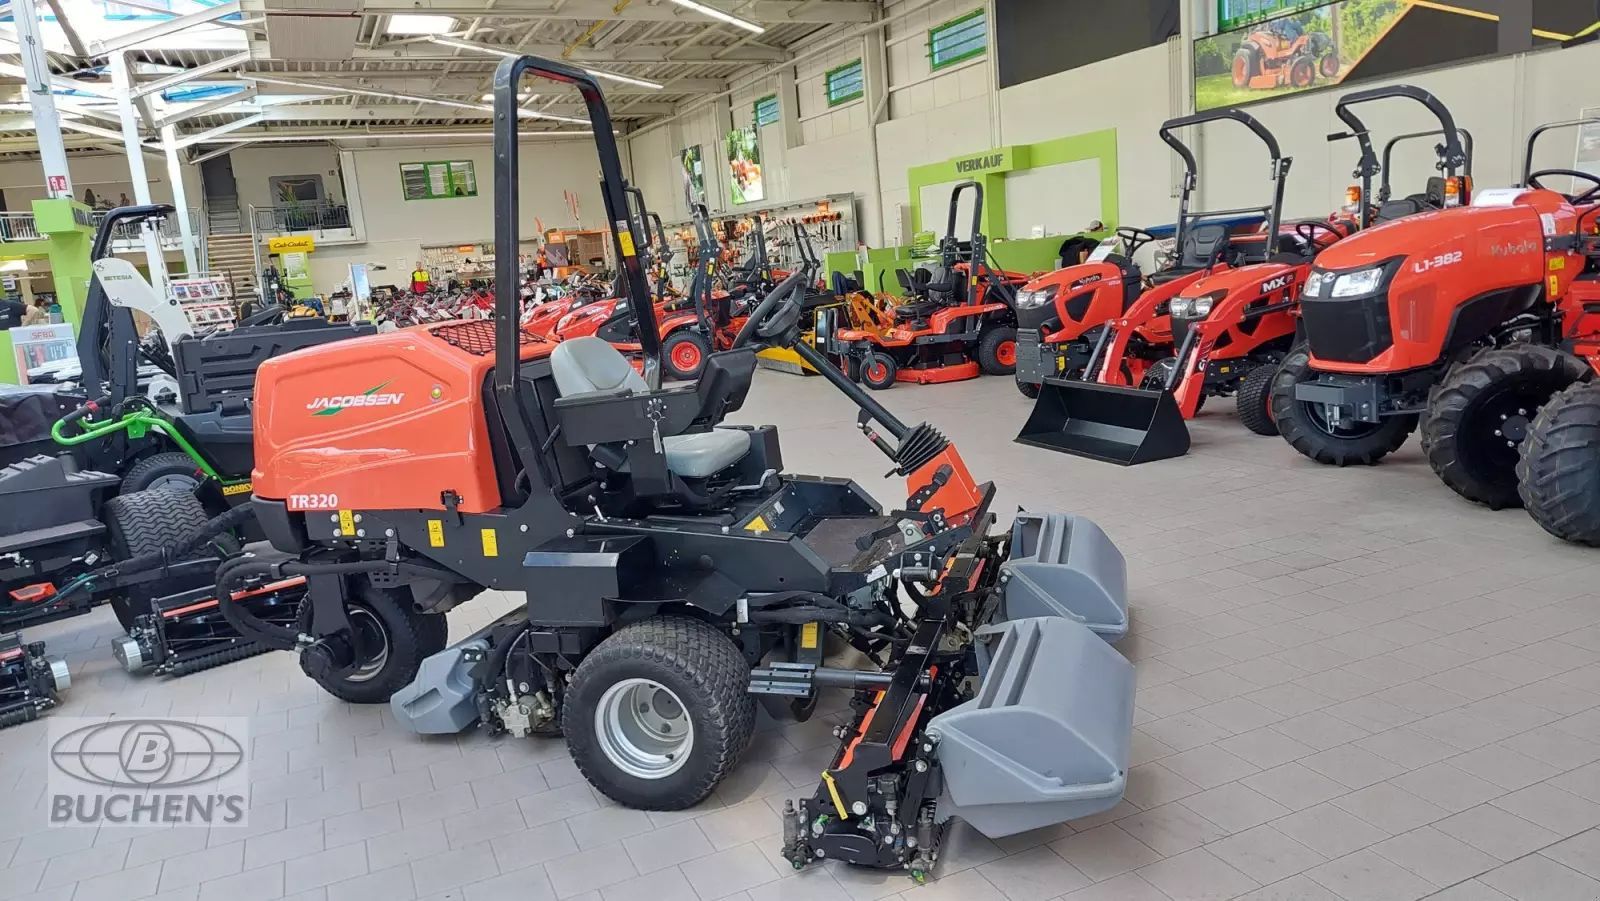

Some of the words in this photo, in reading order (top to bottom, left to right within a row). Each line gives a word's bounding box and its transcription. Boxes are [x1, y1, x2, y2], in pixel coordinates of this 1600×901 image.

[956, 154, 1003, 173] VERKAUF
[1490, 240, 1537, 257] Kubota
[1413, 250, 1463, 273] L1-382
[1263, 275, 1286, 292] MX
[306, 393, 405, 409] JACOBSEN
[290, 493, 338, 509] TR320
